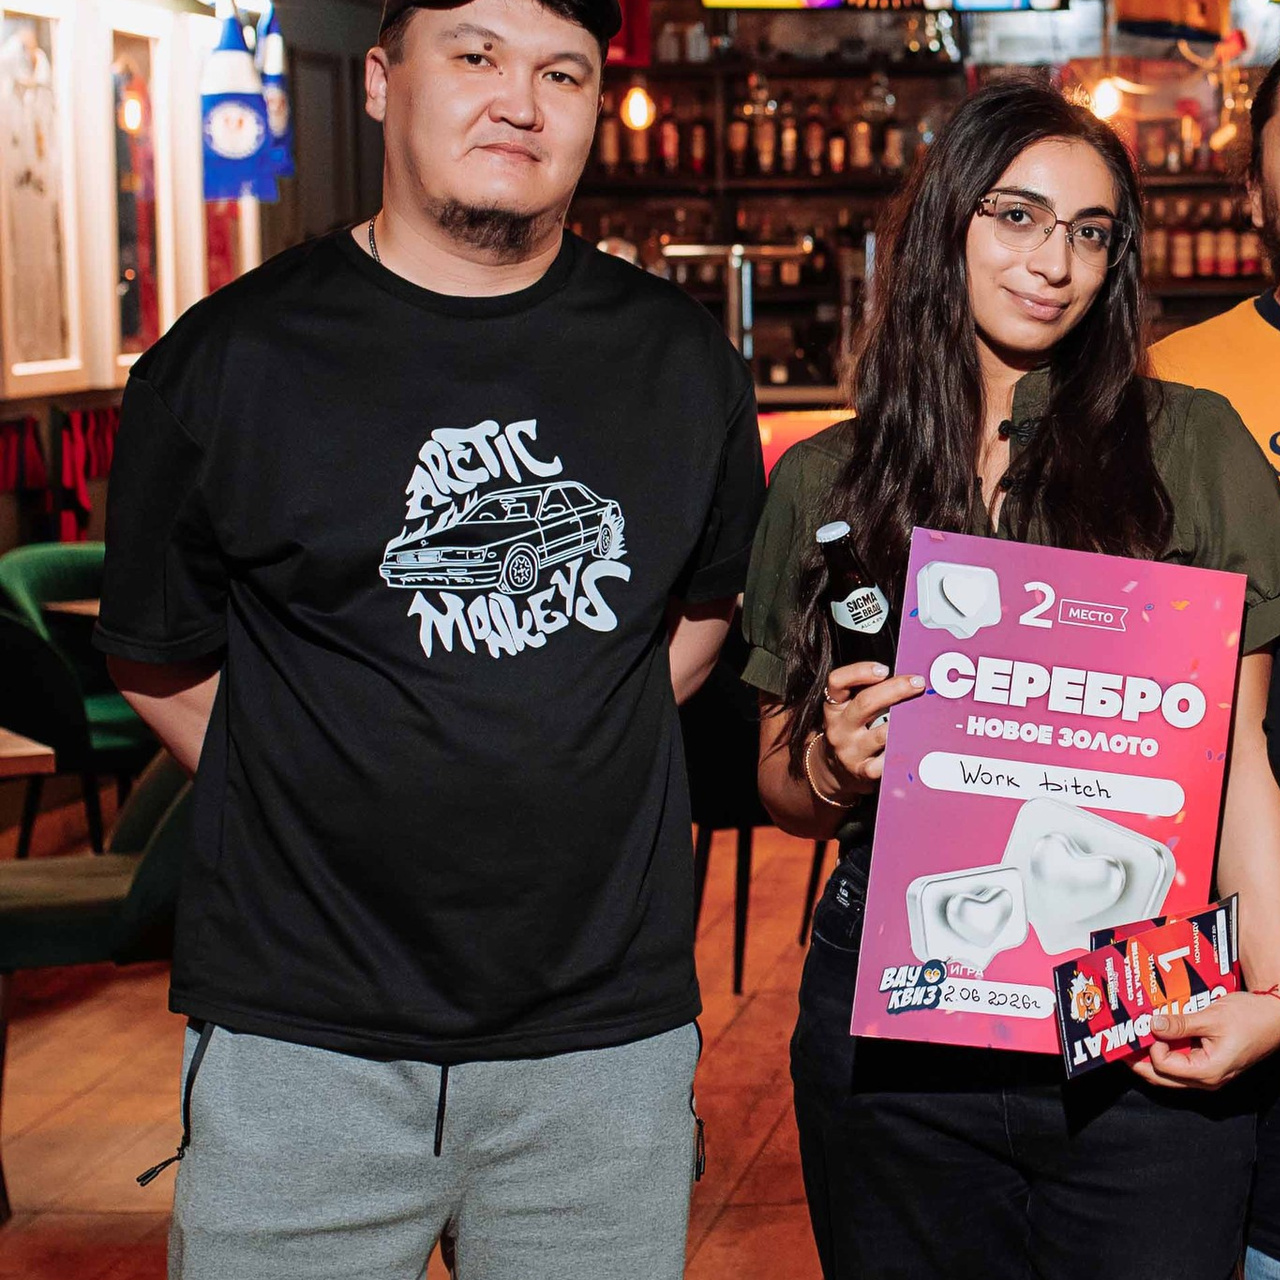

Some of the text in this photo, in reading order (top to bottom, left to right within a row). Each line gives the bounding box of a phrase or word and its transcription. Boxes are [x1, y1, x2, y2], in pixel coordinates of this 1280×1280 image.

[405, 419, 563, 520] ARCTIC
[406, 557, 631, 659] MONKEYS
[846, 591, 878, 613] SIGMA
[862, 602, 882, 617] BRAU
[1019, 581, 1114, 629] 2 МЕСТО
[929, 651, 1207, 729] СЕРЕБРО
[966, 715, 1054, 745] НОВОЕ
[1058, 727, 1159, 758] ЗОЛОТО
[960, 760, 1112, 799] Work bitch
[1148, 954, 1154, 970] НА
[1158, 946, 1191, 973] 1
[1192, 921, 1200, 964] КОМАНДУ
[879, 966, 923, 993] ВАУ
[950, 964, 984, 979] ИГРА
[1124, 957, 1134, 1000] СКИДКА
[1131, 942, 1144, 1006] НА УЧАСТИЕ
[1149, 971, 1158, 994] 50%
[887, 985, 938, 1010] КВИЗ
